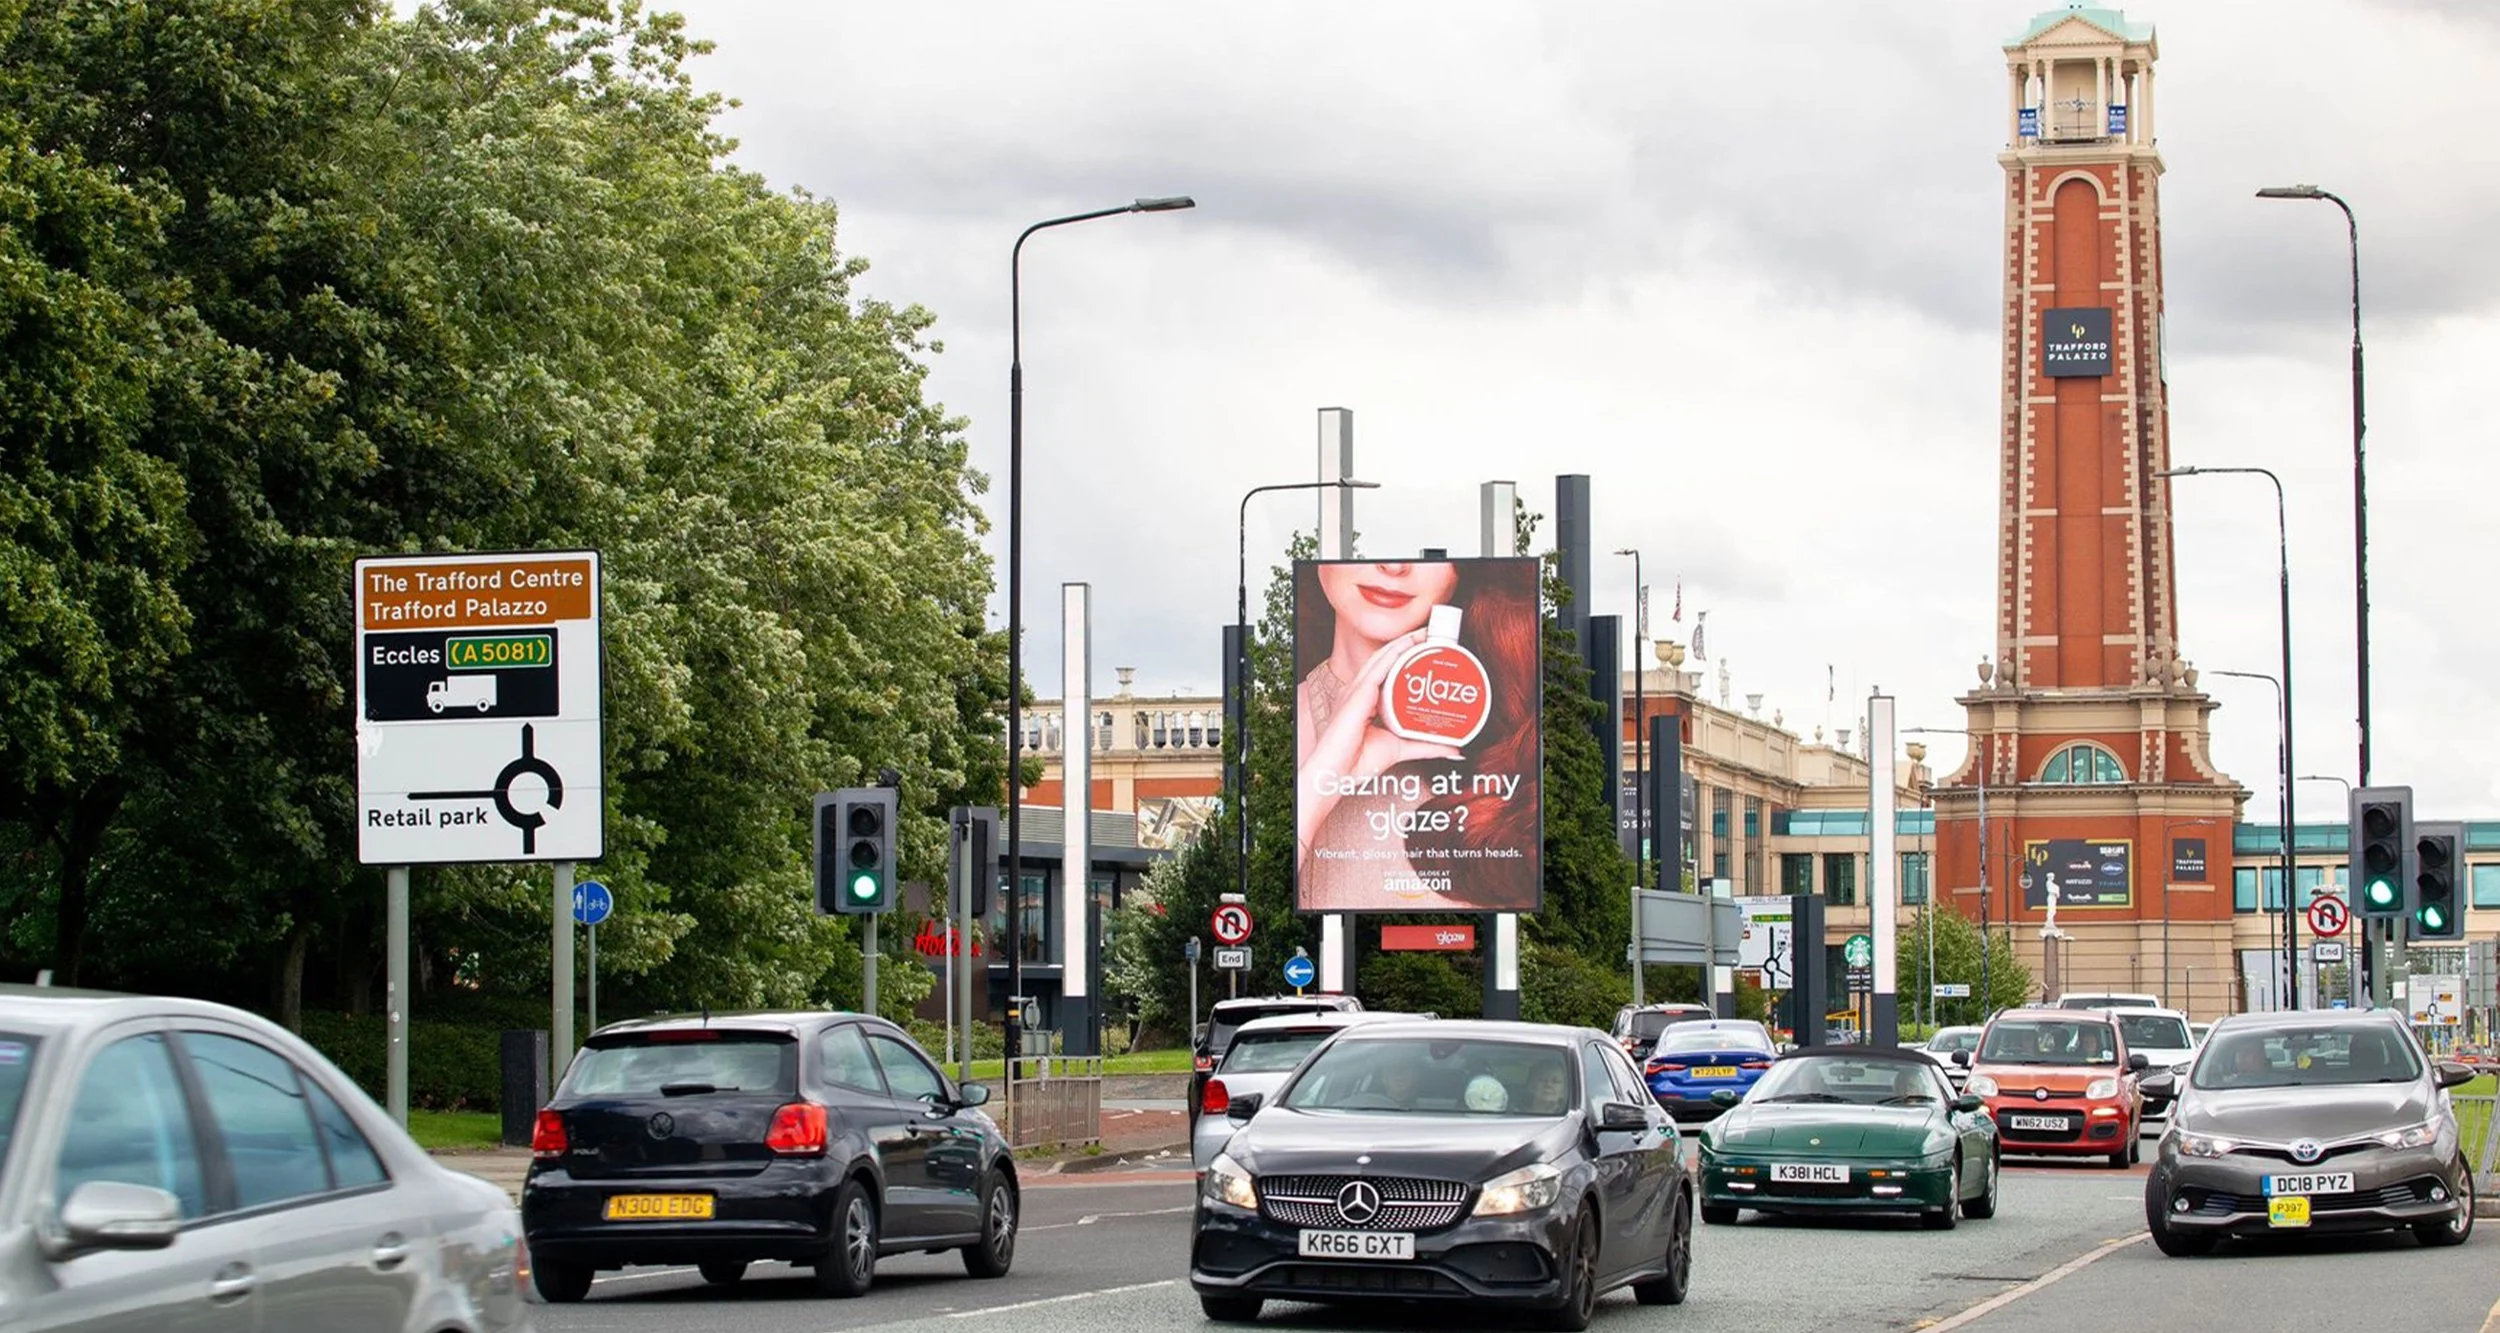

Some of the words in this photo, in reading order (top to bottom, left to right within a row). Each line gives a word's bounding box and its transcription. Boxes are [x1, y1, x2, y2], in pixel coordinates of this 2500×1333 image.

[2048, 342, 2107, 352] TRAFFORD
[2048, 352, 2107, 361] PALAZZO
[370, 574, 408, 592] The
[415, 570, 501, 591] Trafford
[510, 569, 583, 587] Centre
[370, 600, 456, 621] Trafford
[466, 598, 547, 617] Palazzo
[373, 645, 440, 665] Eccles
[1406, 669, 1478, 705] glaze
[1312, 769, 1420, 800] Gazing
[1431, 770, 1462, 795] at
[1472, 774, 1521, 800] my
[368, 808, 432, 827] Retail
[440, 806, 488, 828] park
[1314, 848, 1358, 859] Vibrant,
[1362, 848, 1398, 860] glossy
[1401, 847, 1423, 858] hair
[1426, 847, 1450, 858] that
[1453, 848, 1482, 858] turns
[1485, 847, 1523, 858] heads.
[1441, 869, 1451, 877] AT
[1383, 878, 1452, 892] amazon
[2319, 946, 2339, 956] End
[1221, 954, 1241, 963] End
[2044, 1118, 2065, 1129] USZ
[1780, 1166, 1810, 1180] K381
[1813, 1166, 1841, 1180] HCL
[2277, 1176, 2312, 1192] DC18
[2317, 1175, 2348, 1190] PYZ
[616, 1197, 663, 1214] N300
[669, 1196, 704, 1214] EDG
[2277, 1203, 2303, 1212] P397
[1307, 1233, 1359, 1253] KR66
[1365, 1235, 1405, 1255] GXT
